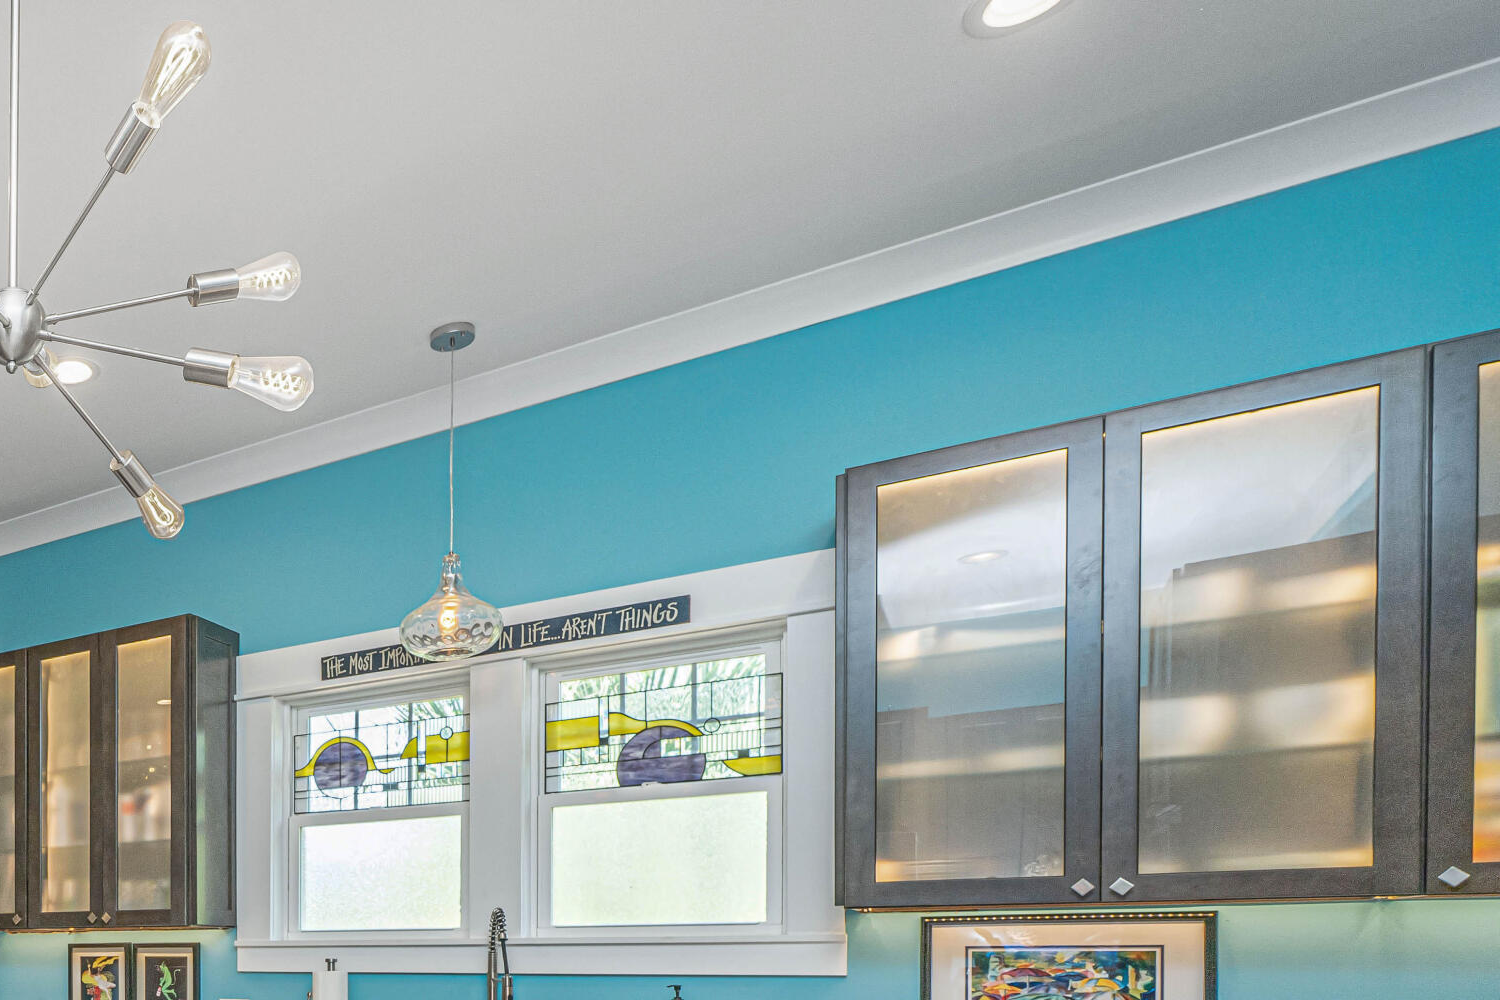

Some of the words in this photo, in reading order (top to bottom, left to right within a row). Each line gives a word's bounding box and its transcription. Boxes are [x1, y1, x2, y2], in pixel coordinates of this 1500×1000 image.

[323, 655, 347, 679] THE
[349, 651, 378, 675] MOST
[616, 601, 679, 632] THINGS
